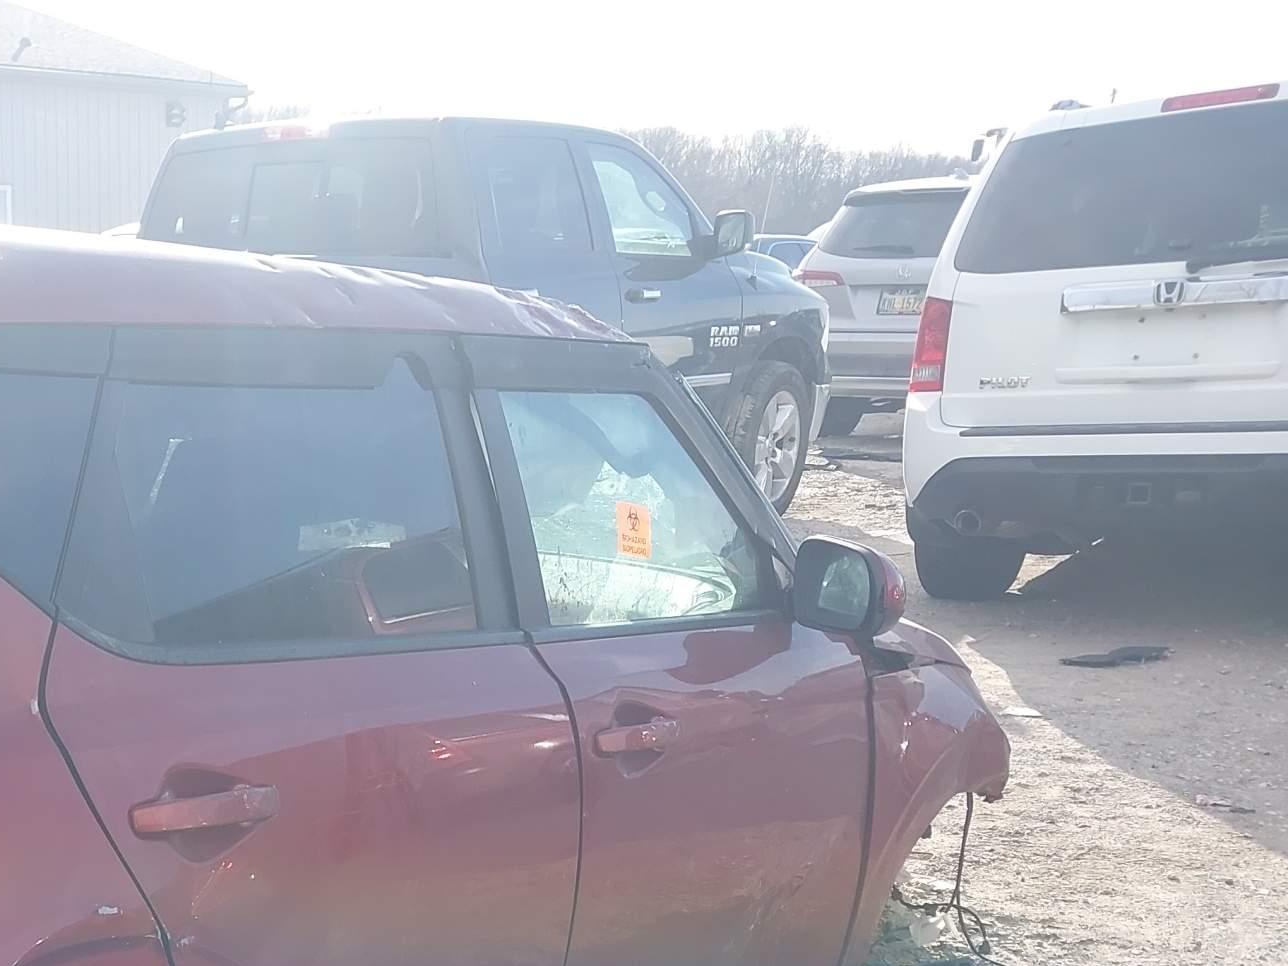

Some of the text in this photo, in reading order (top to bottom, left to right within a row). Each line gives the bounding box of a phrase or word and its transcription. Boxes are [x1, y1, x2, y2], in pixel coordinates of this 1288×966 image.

[710, 325, 740, 337] RAM
[709, 336, 739, 347] 1500
[978, 375, 1031, 390] PILOT
